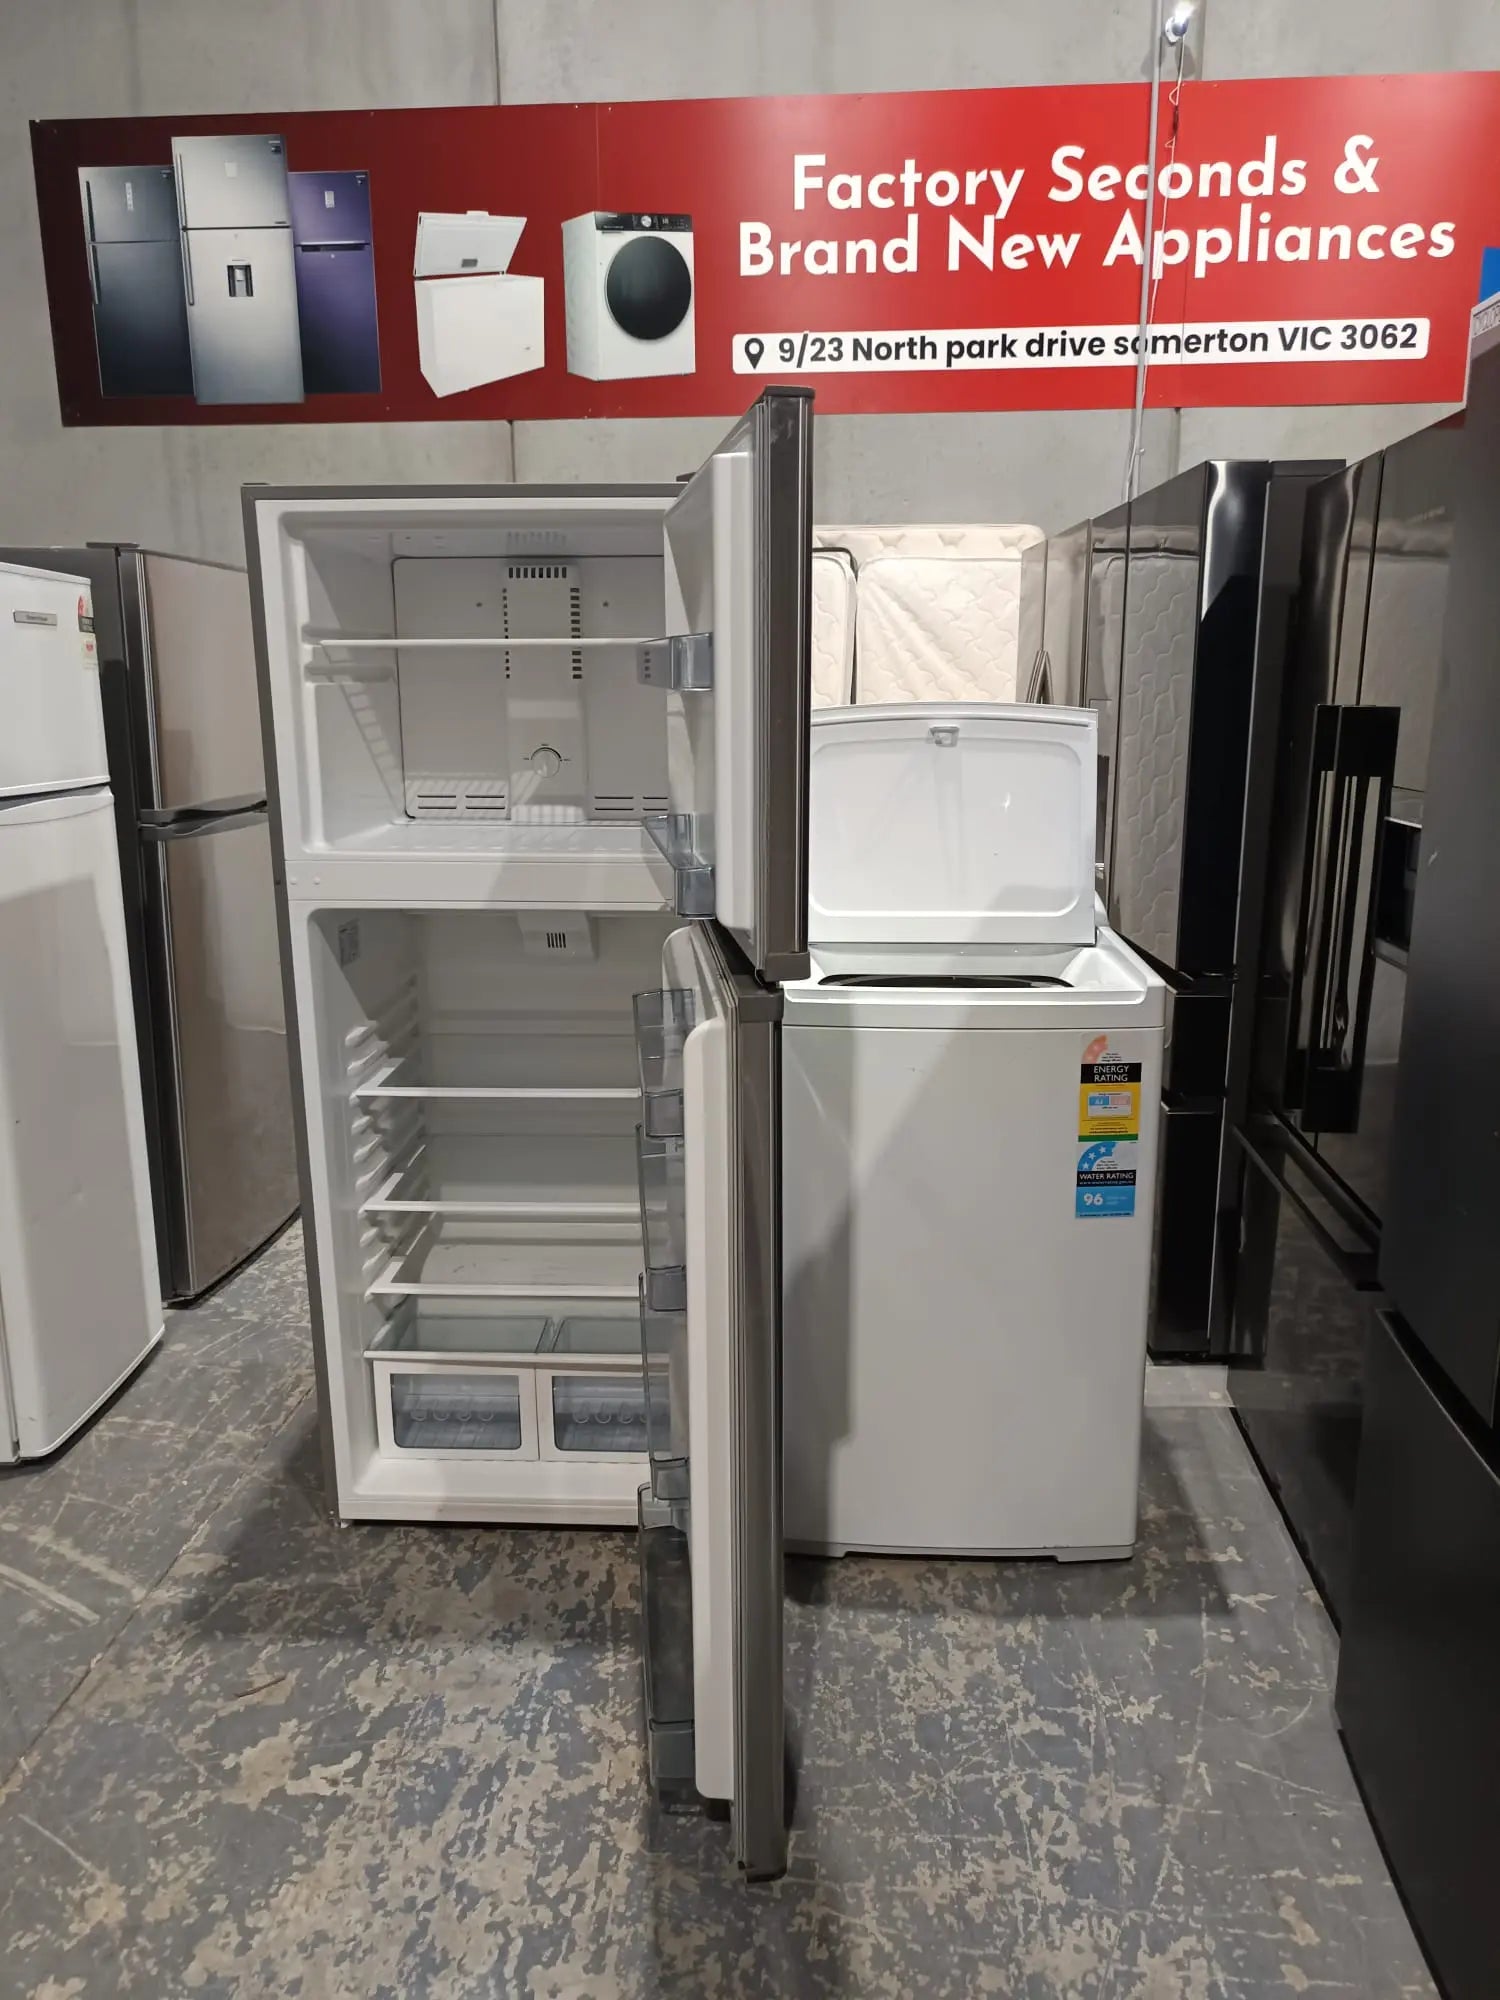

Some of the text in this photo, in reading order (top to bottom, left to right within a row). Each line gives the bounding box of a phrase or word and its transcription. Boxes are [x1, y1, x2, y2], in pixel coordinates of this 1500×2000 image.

[793, 134, 1381, 219] Factory Seconds &
[739, 203, 1456, 280] Brand New Appliances
[778, 323, 1418, 368] 9/23 North park drive somerton VIC 3062
[1093, 1065, 1130, 1074] ENERGY
[1094, 1074, 1129, 1082] RATING
[1106, 1172, 1134, 1180] RATING
[1083, 1192, 1104, 1206] 96
